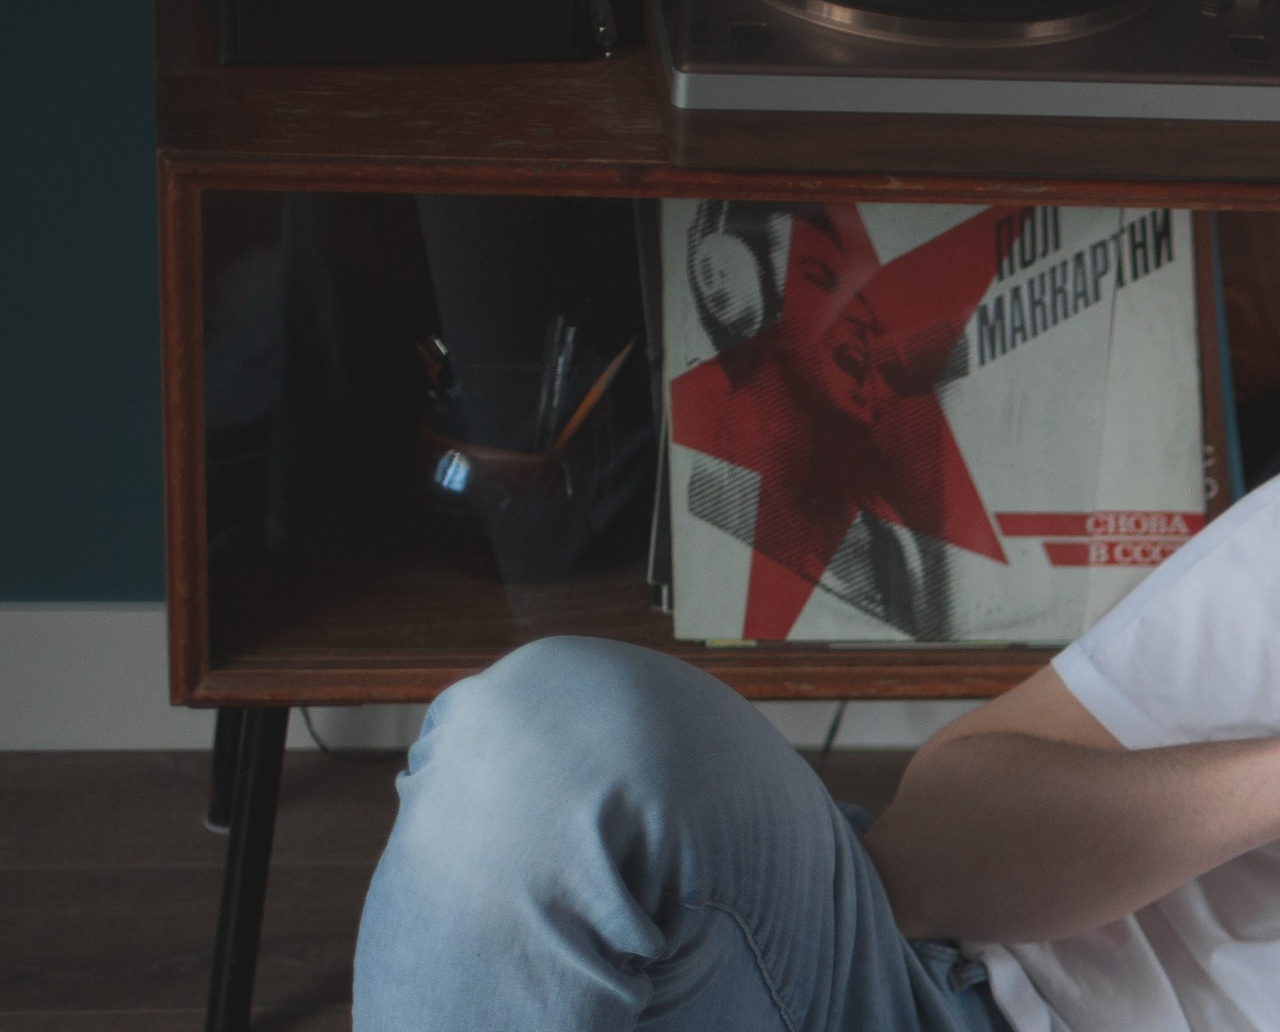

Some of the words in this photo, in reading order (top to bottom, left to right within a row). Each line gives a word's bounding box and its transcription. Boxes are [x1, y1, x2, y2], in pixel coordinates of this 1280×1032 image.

[976, 208, 1175, 367] МАККАРТНИ
[1085, 513, 1189, 535] СНОВА
[1089, 543, 1108, 563] В
[1113, 543, 1178, 564] ССС
